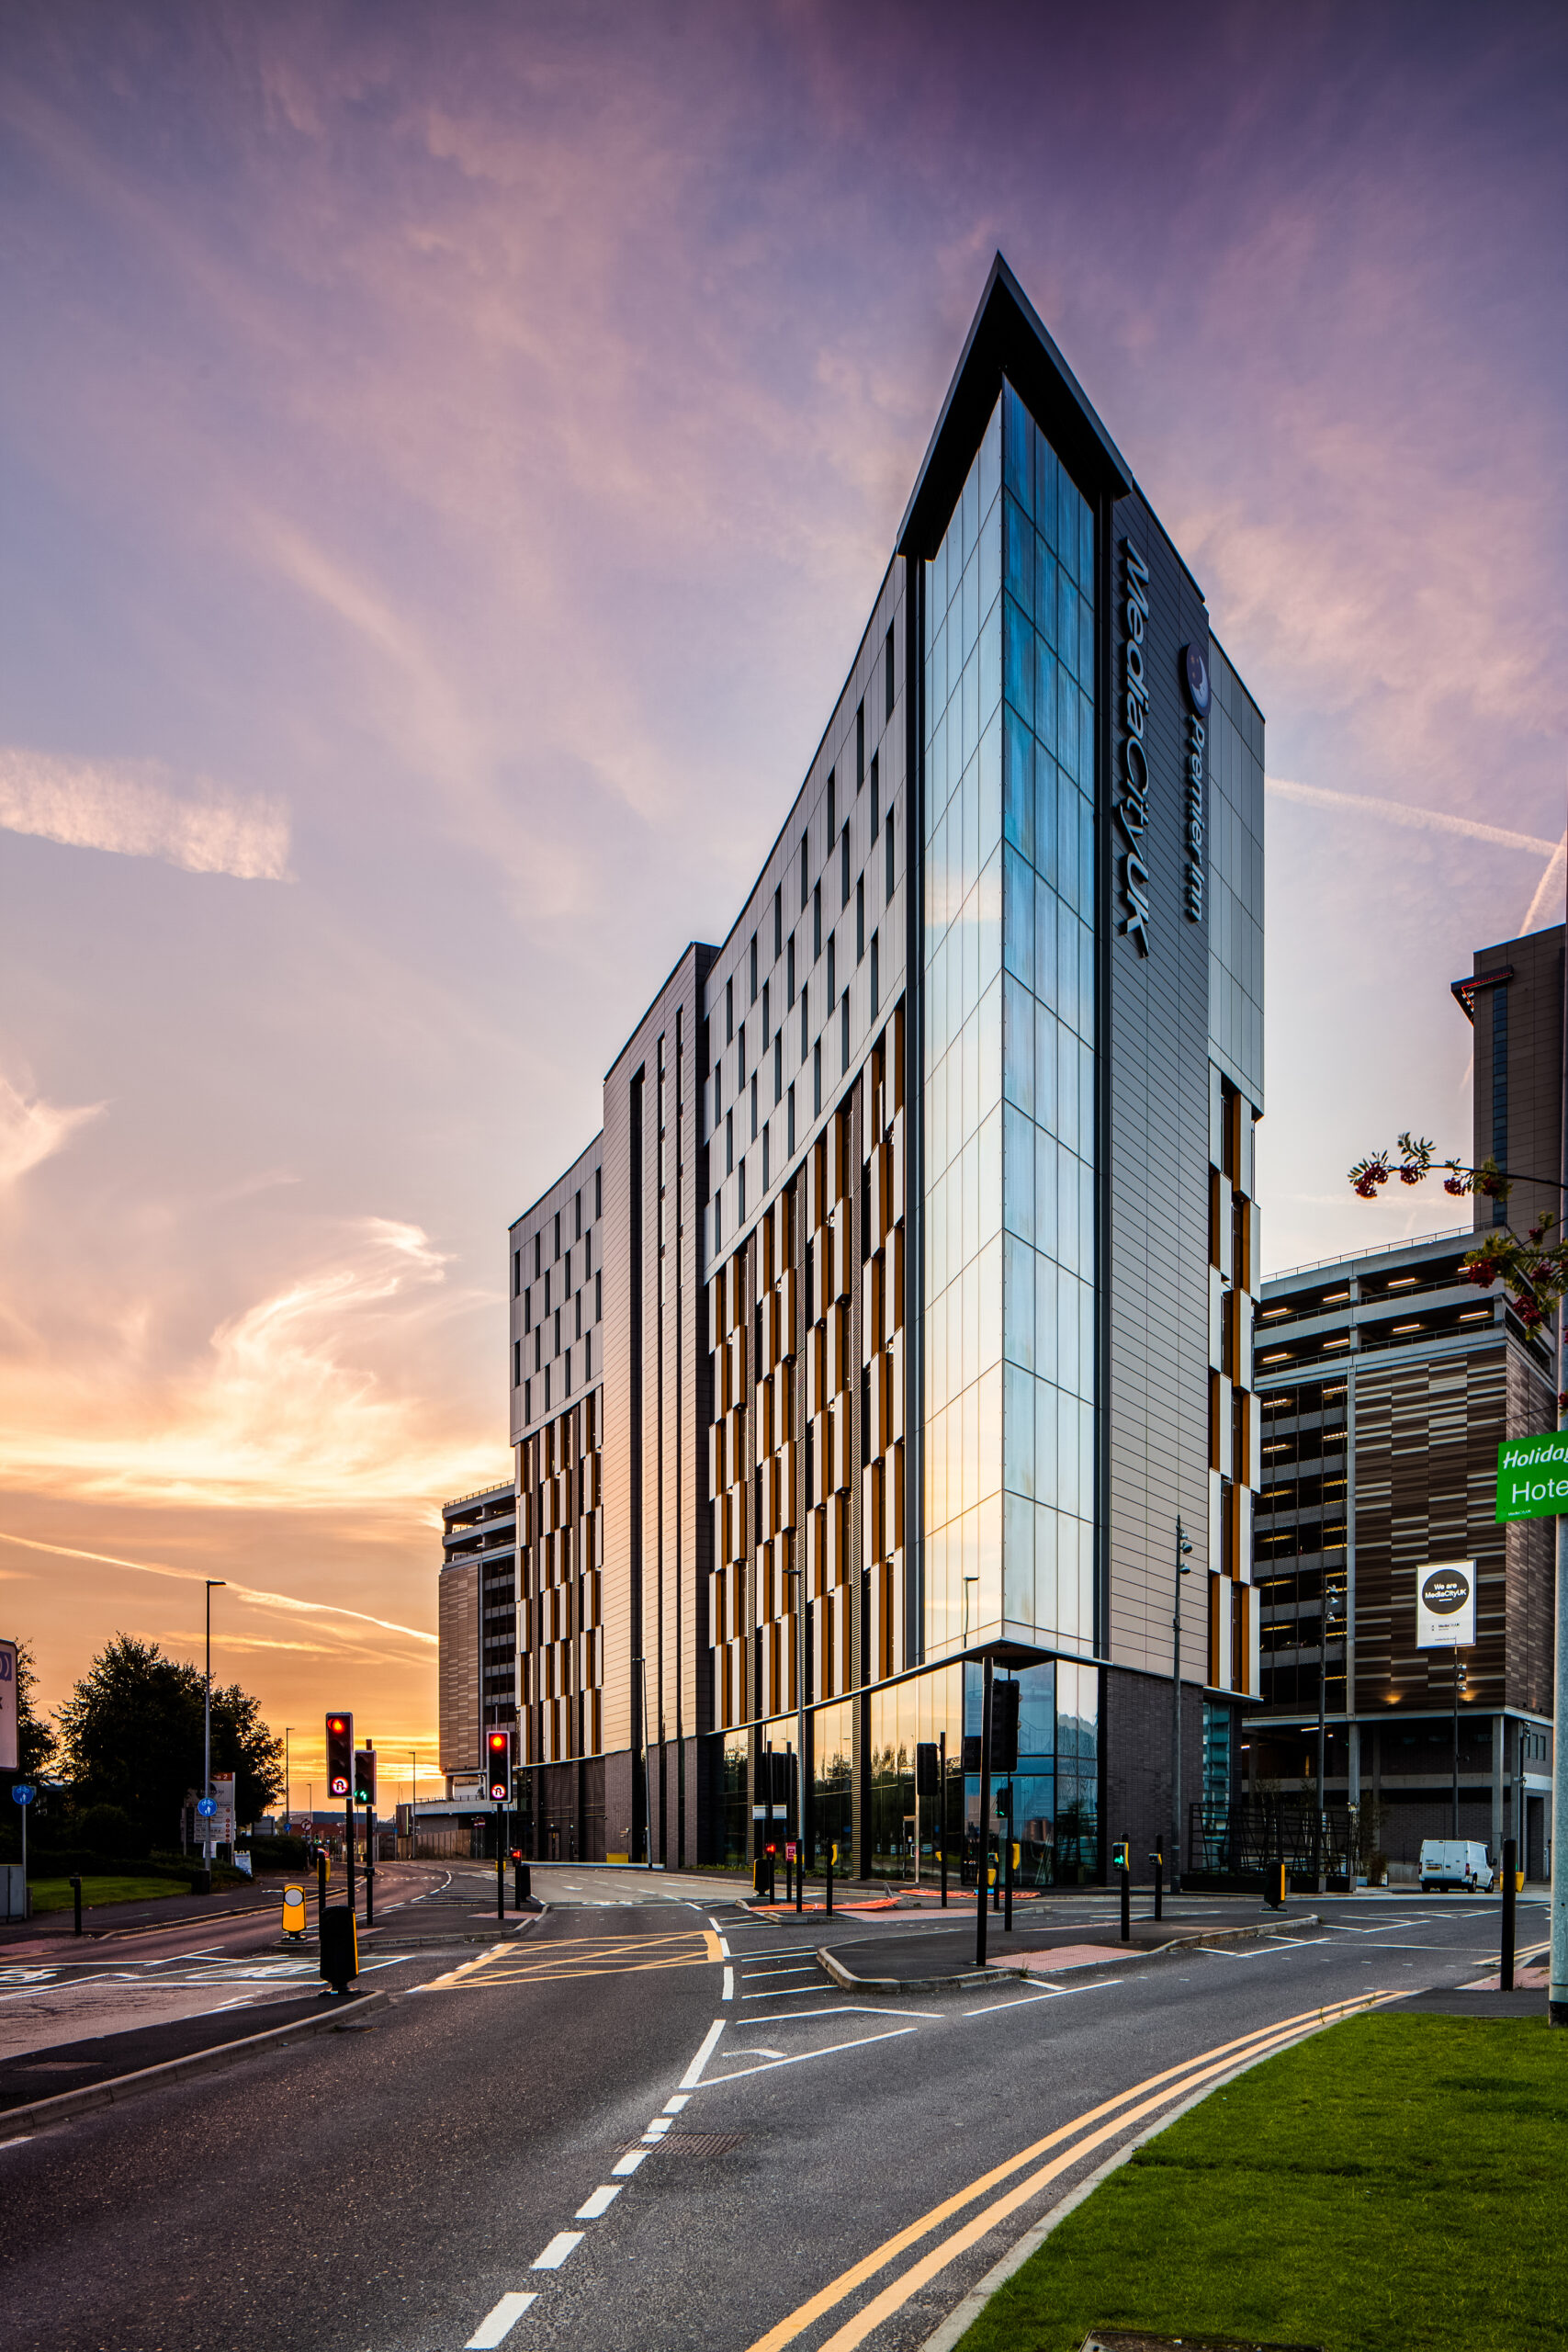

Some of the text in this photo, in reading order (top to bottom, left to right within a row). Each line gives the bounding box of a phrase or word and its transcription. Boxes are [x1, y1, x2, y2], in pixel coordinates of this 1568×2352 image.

[1120, 537, 1149, 958] MediaCityUK
[1189, 713, 1205, 922] Premier Inn
[1425, 1589, 1467, 1599] MediaCityUK
